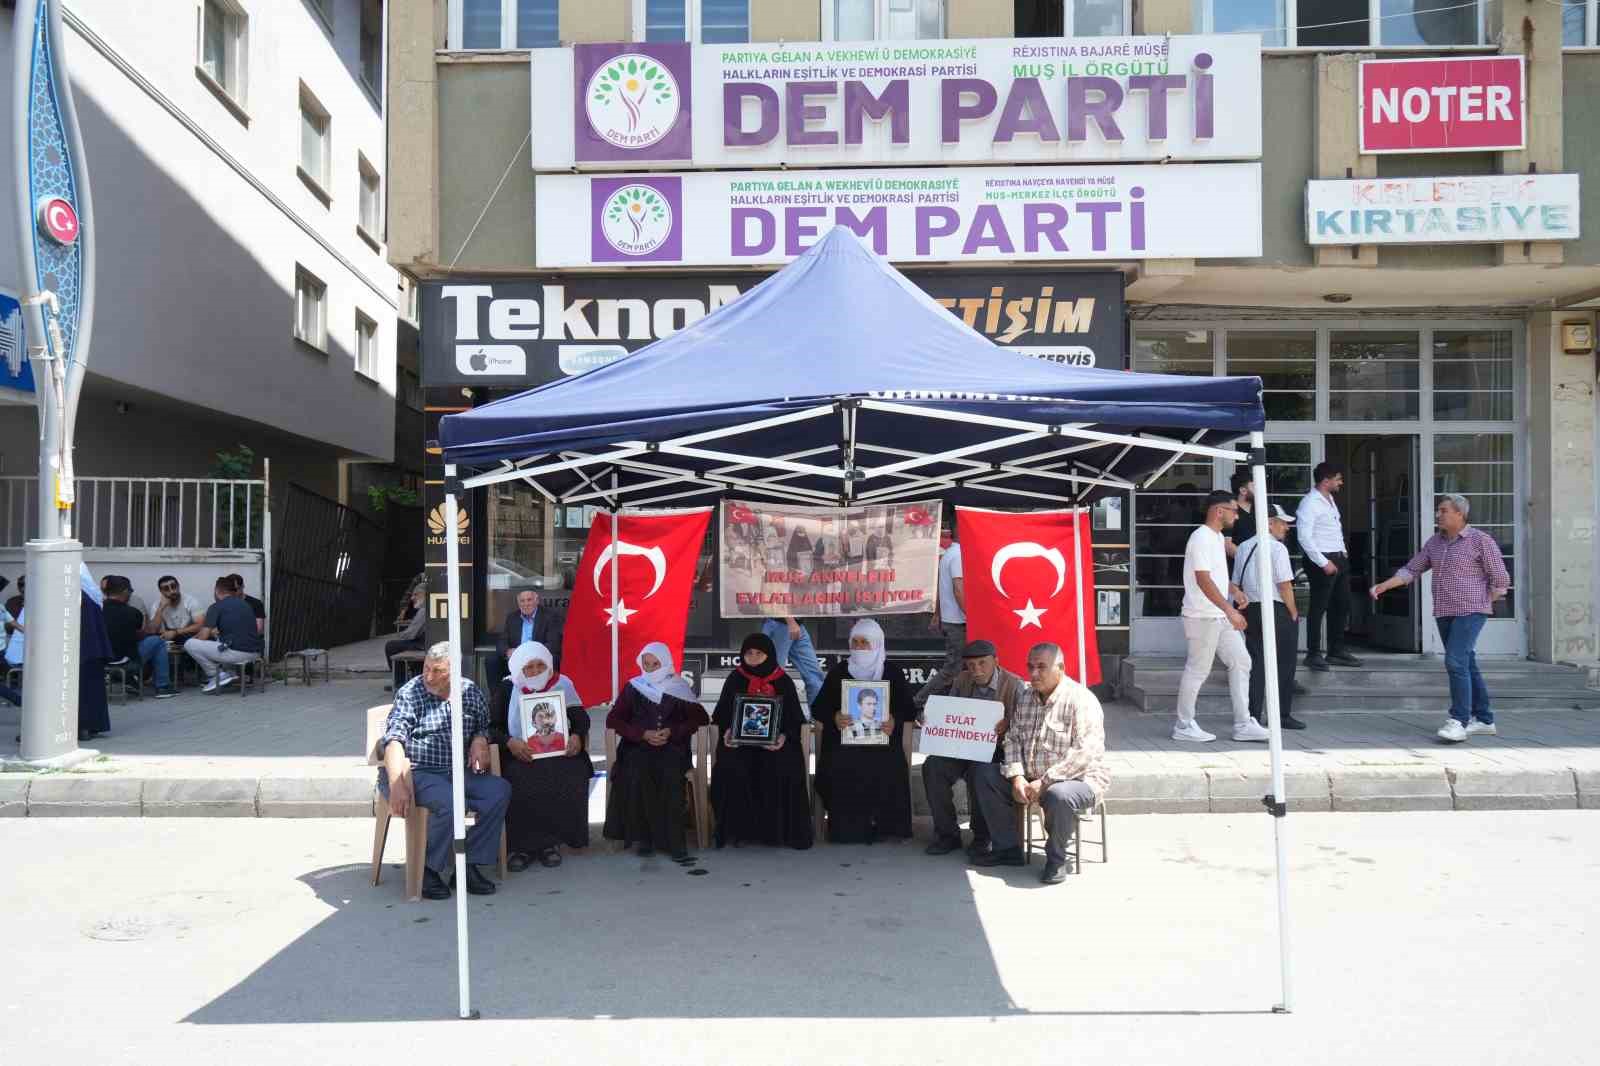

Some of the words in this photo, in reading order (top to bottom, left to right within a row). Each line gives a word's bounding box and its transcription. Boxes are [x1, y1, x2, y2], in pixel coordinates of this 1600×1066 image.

[721, 52, 768, 64] PARTIYA
[771, 52, 811, 63] GELAN
[815, 51, 824, 62] A
[1080, 43, 1130, 57] BAJARÊ
[722, 69, 791, 80] HALKLARIN
[793, 66, 838, 80] EŞİTLİK
[841, 68, 857, 78] VE
[859, 64, 926, 78] DEMOKRASİ
[931, 63, 977, 76] PARTİSİ
[1013, 63, 1055, 80] MUŞ
[1062, 60, 1078, 76] İL
[1085, 58, 1169, 76] ÖRGÜTÜ
[723, 80, 910, 146] DEM
[941, 52, 1214, 144] PARTİ
[1372, 85, 1514, 124] NOTER
[607, 128, 628, 144] DEM
[630, 125, 660, 144] PARTİ
[730, 181, 775, 191] PARTIYA
[777, 181, 813, 191] GELAN
[815, 181, 823, 190] A
[1052, 189, 1074, 199] İLÇE
[1076, 187, 1116, 198] ÖRGÜTÜ
[730, 195, 792, 204] HALKLARIN
[794, 192, 834, 205] EŞİTLİK
[836, 194, 851, 203] VE
[853, 192, 913, 203] DEMOKRASİ
[918, 192, 959, 203] PARTİSİ
[730, 206, 888, 257] DEM
[915, 186, 1146, 256] PARTİ
[1317, 202, 1571, 235] KIRTASİYE
[616, 239, 633, 251] DEM
[427, 536, 470, 545] HUAEI
[765, 570, 804, 584] MUŞ
[810, 569, 896, 584] ANNELERİ
[855, 588, 923, 605] İSTİYOR
[944, 714, 976, 726] EVLAT
[925, 726, 997, 744] NÖBETİNDEYİZ
